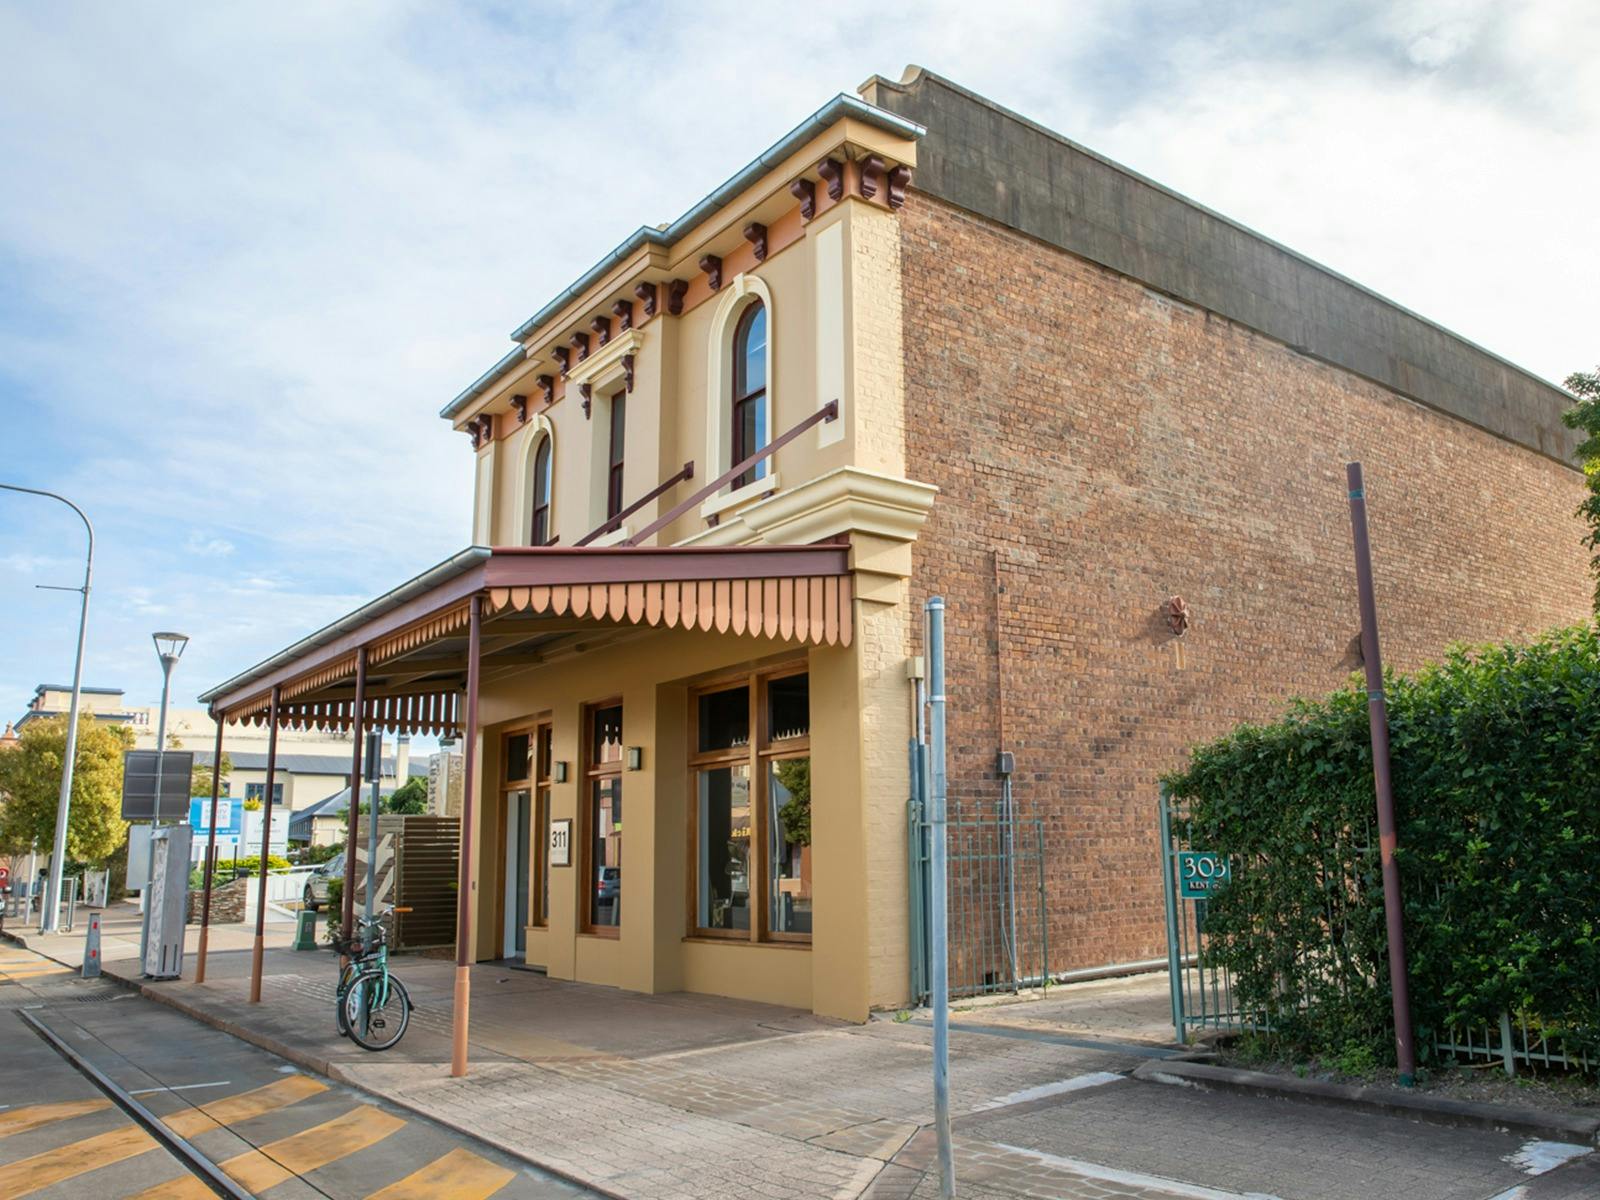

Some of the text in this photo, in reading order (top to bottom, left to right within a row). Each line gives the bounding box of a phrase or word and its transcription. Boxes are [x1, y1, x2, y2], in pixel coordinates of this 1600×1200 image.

[552, 831, 566, 847] 311
[1185, 857, 1226, 878] 303
[1190, 881, 1209, 889] KENT
